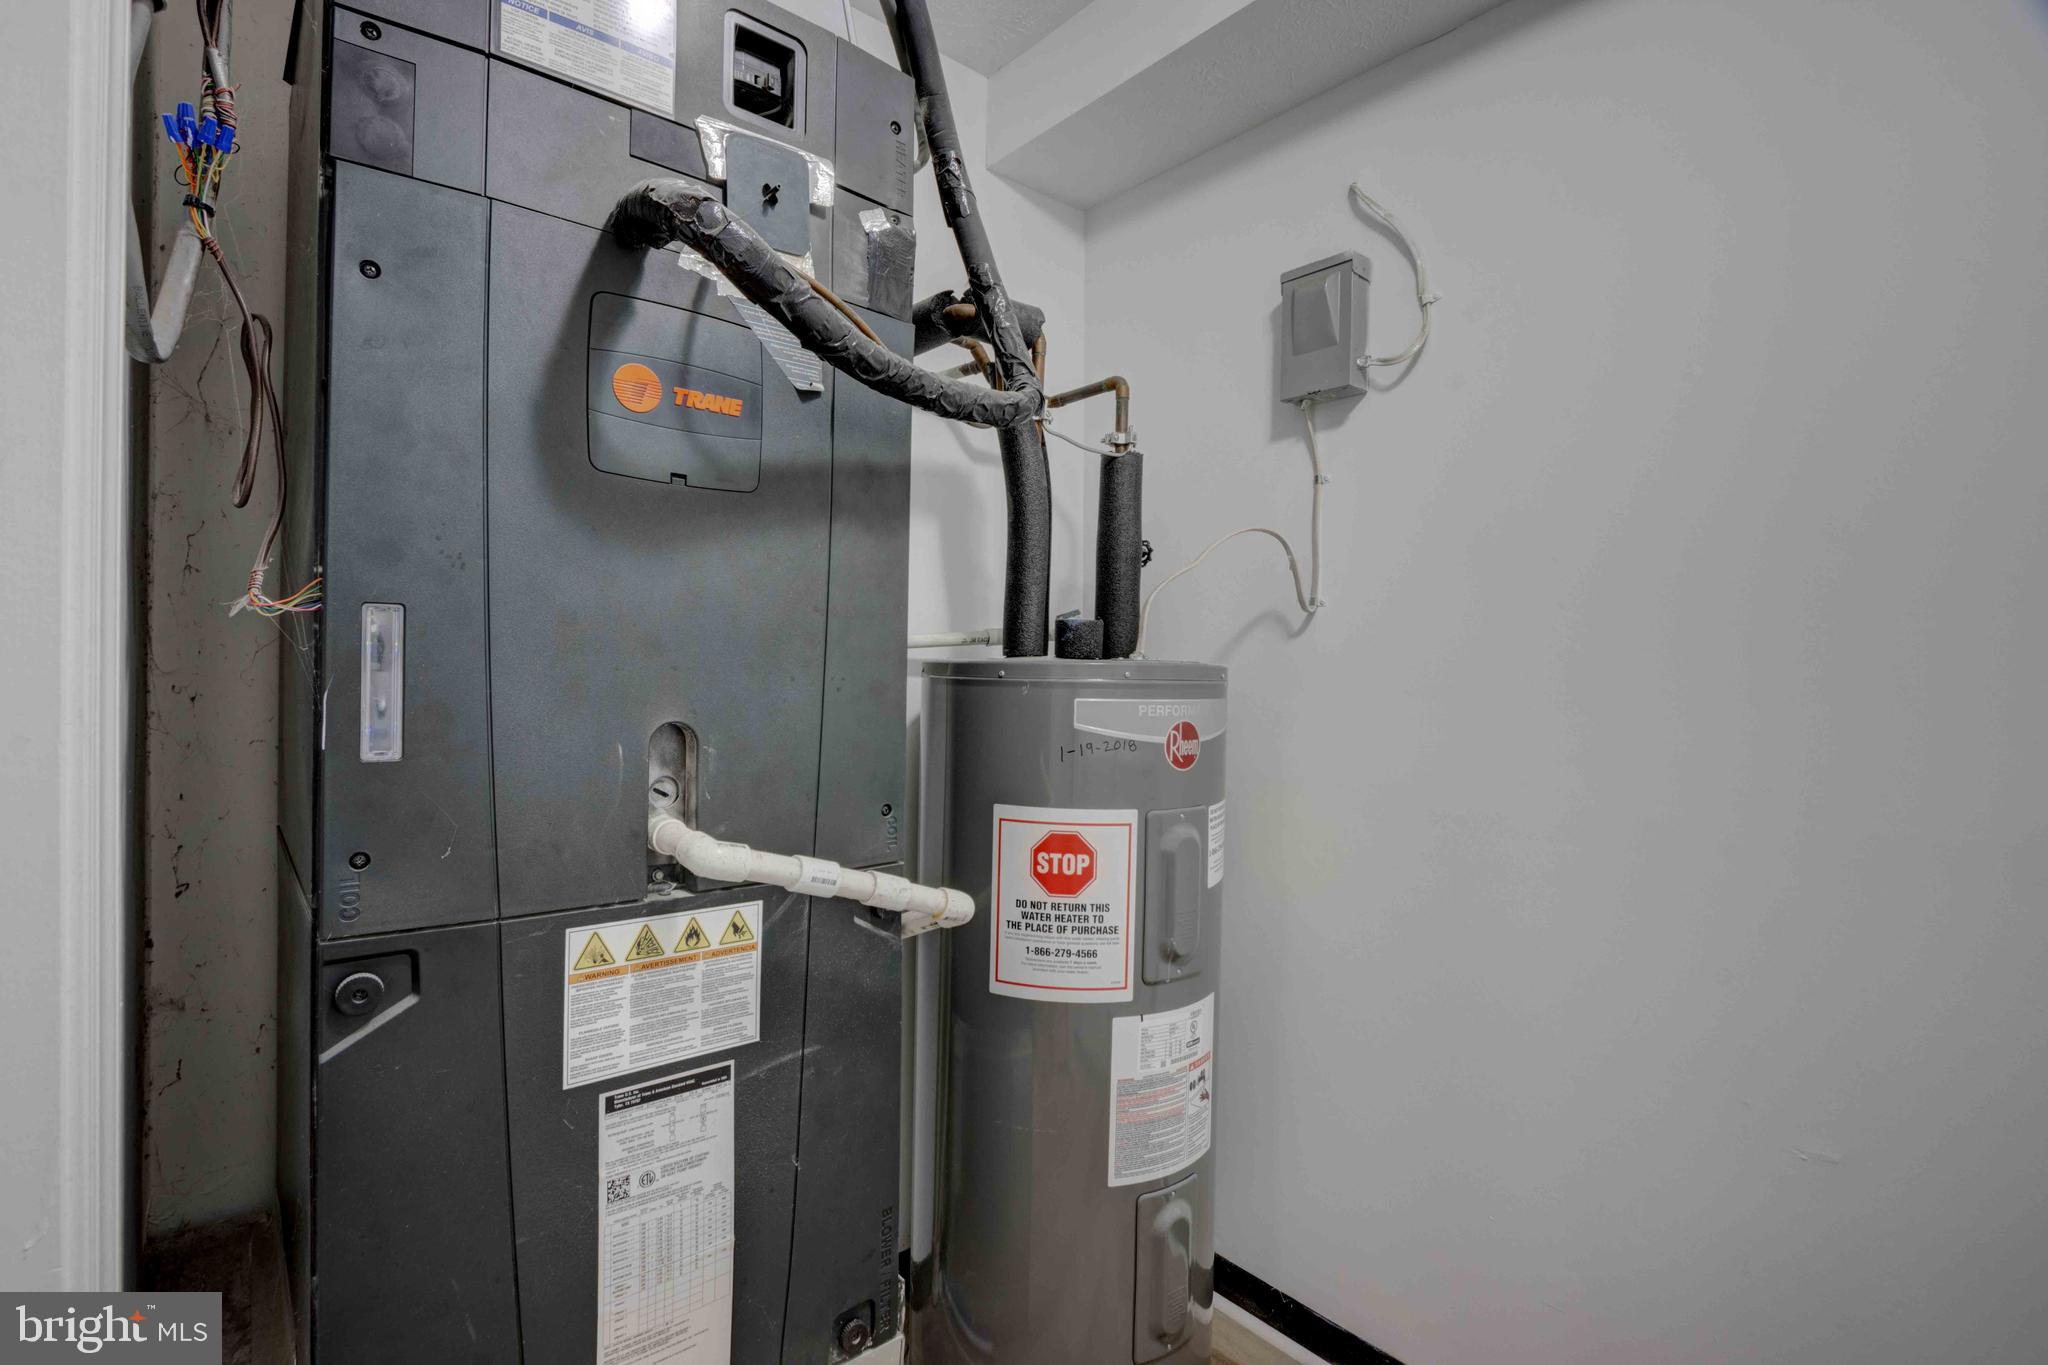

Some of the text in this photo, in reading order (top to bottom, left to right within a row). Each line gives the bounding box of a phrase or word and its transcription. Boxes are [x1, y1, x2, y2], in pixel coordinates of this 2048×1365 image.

[508, 0, 540, 14] NOTICE
[575, 24, 595, 36] AVIS
[673, 386, 744, 417] TRANE
[1169, 722, 1199, 763] Rheem
[1060, 740, 1138, 763] 1-19-2018
[1036, 851, 1090, 876] STOP
[338, 874, 361, 922] COIL
[1015, 899, 1111, 913] DO NOT RETURN THIS
[1021, 911, 1104, 924] WATER HEATER TO
[1006, 920, 1120, 935] THE PLACE OF PURCHASE
[711, 944, 756, 957] ADVERTENCIA
[1025, 946, 1098, 959] 1-866-279-4566
[640, 954, 697, 970] AVERTISSEMENT
[584, 968, 621, 981] WARNING
[881, 1206, 893, 1270] BLOWER
[879, 1279, 892, 1335] FILTER
